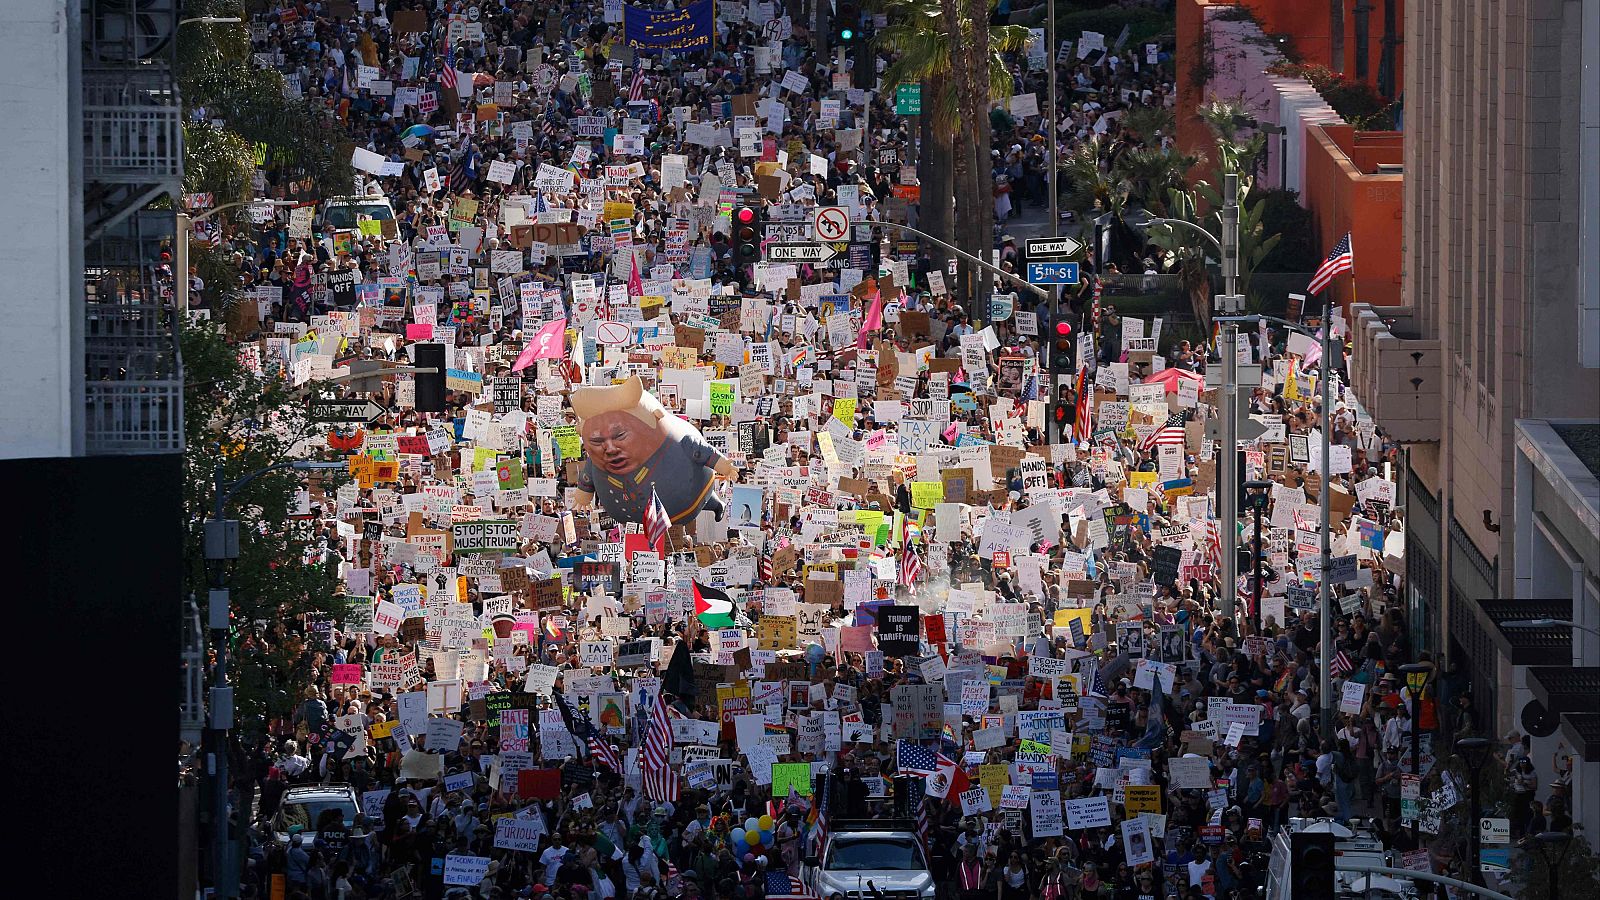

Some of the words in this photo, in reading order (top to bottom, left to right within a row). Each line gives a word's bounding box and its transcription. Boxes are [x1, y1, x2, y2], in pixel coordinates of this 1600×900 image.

[606, 167, 628, 177] TRAITOR
[768, 226, 798, 234] HANDS
[775, 248, 796, 257] ONE
[802, 248, 822, 257] WAY
[1032, 244, 1046, 252] ONE
[330, 272, 353, 283] HANDS
[1035, 267, 1054, 280] 5th
[1060, 268, 1072, 278] St
[335, 282, 351, 292] OFF
[414, 306, 434, 316] WHAT
[276, 324, 300, 333] Hands
[494, 391, 501, 399] IS
[502, 391, 518, 399] THE
[712, 405, 730, 414] YOU
[836, 400, 855, 409] DOGE
[912, 400, 933, 415] STOP!
[345, 406, 366, 416] WAY
[903, 422, 931, 435] TAX
[1022, 461, 1045, 472] HANDS
[1024, 475, 1046, 489] OFF!
[425, 488, 454, 498] TRUMP
[368, 524, 377, 532] NO
[455, 525, 482, 536] STOP
[486, 525, 516, 534] STOP
[454, 537, 483, 548] MUSK
[486, 536, 516, 547] TRUMP
[597, 543, 623, 553] HANDS
[502, 569, 526, 580] DOGE
[487, 599, 509, 609] HANDS
[991, 606, 1010, 615] WAKE
[879, 633, 918, 642] TARIFFYING
[588, 644, 608, 653] TAX
[579, 654, 612, 663] WEALTH
[1034, 657, 1063, 666] PEOPLE
[372, 665, 403, 674] TARIFFS
[405, 668, 418, 677] THE
[1033, 666, 1062, 675] PROFIT
[405, 675, 420, 687] ARTS
[724, 699, 748, 709] HANDS
[501, 711, 528, 724] HATE
[806, 718, 819, 726] NOT
[1198, 722, 1213, 730] FUCK
[500, 739, 528, 751] GREAT
[960, 789, 984, 801] HANDS
[967, 796, 984, 805] OFF!
[496, 825, 537, 841] FURIOUS
[513, 841, 537, 851] WORDS
